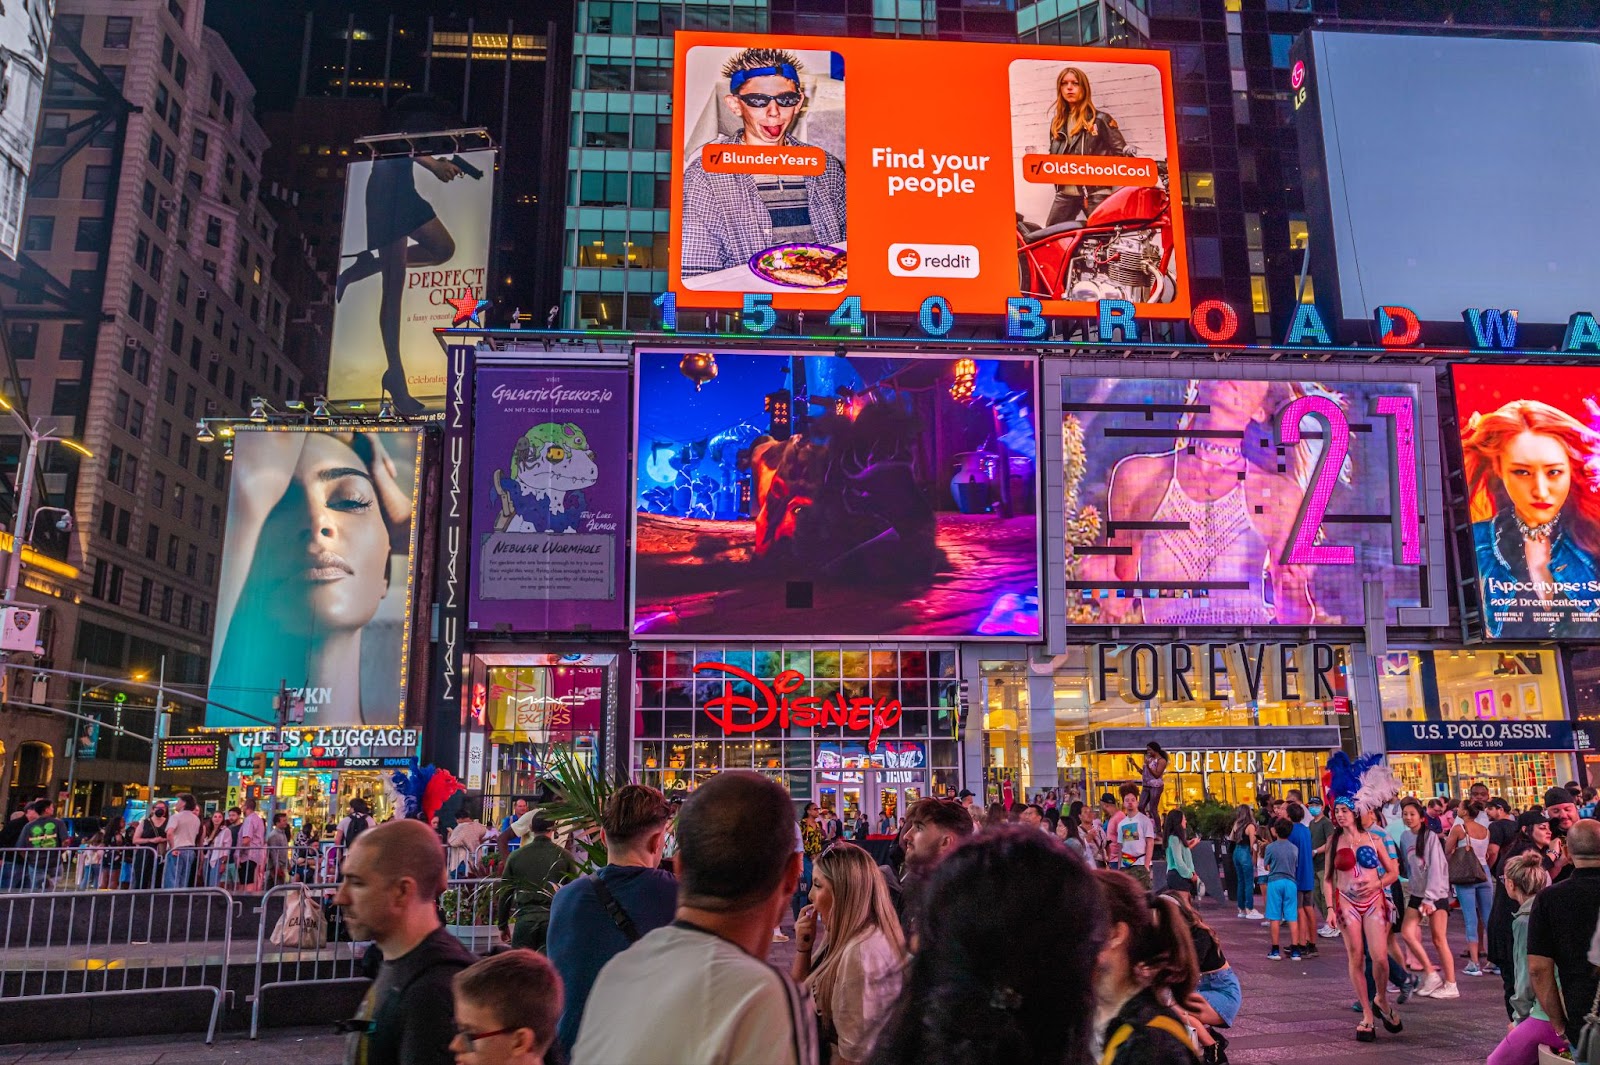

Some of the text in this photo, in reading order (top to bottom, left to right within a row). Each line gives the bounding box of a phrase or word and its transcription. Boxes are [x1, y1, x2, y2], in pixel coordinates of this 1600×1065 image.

[1294, 86, 1307, 111] LG
[710, 151, 818, 167] r/BlunderYears
[872, 147, 990, 175] Find your
[1031, 160, 1151, 177] r/OldSchoolCool
[888, 172, 976, 198] people
[925, 253, 971, 269] reddit
[408, 268, 485, 289] PERFECT
[1274, 395, 1421, 565] 21
[586, 519, 617, 531] ARMOR
[493, 541, 602, 554] NEBULAR WORMHOLE
[1490, 598, 1518, 607] 2022
[1520, 598, 1592, 607] Dreamcatcher
[1097, 643, 1335, 701] FOREVER
[517, 703, 571, 715] COLOUR
[317, 729, 417, 747] LUGGAGE
[1412, 724, 1551, 739] U.S. POLO ASSN.
[166, 744, 215, 757] ELECTRONICS
[306, 746, 347, 757] I NY
[1460, 740, 1503, 748] SINCE 1890
[190, 757, 214, 766] LUGGAGE
[344, 758, 380, 766] SONY
[383, 758, 410, 766] BOWER
[1268, 750, 1286, 772] 21
[229, 786, 237, 807] ATM
